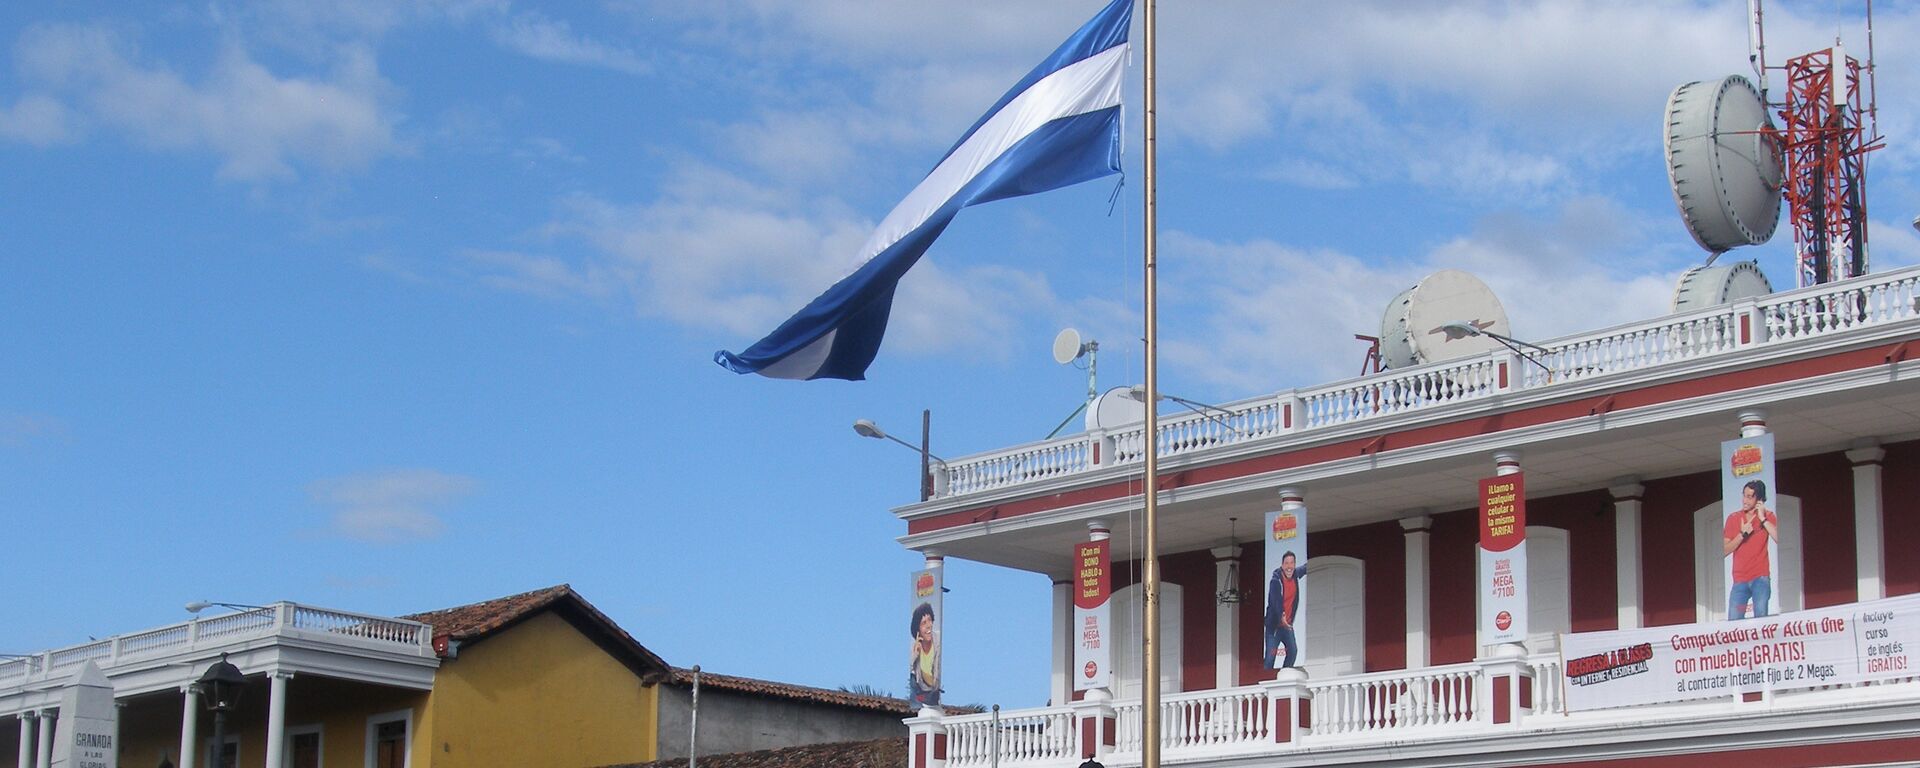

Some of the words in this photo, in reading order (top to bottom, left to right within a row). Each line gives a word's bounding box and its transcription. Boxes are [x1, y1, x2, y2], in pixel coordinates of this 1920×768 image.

[1510, 483, 1514, 491] a
[1487, 494, 1515, 505] cualquier
[1487, 505, 1509, 516] celular
[1487, 518, 1494, 527] la
[1494, 516, 1515, 526] misma
[1491, 525, 1514, 537] TARIFA!
[1093, 545, 1101, 555] mi
[1084, 557, 1099, 567] BONO
[1081, 567, 1098, 578] HABLO
[1098, 568, 1103, 576] a
[1083, 578, 1098, 587] todos
[1493, 575, 1514, 587] MEGA
[1497, 586, 1515, 598] 7100
[1863, 611, 1894, 624] Incluye
[1083, 630, 1100, 640] MEGA
[1671, 628, 1759, 652] Computadora
[1761, 623, 1778, 639] HP
[1784, 620, 1804, 637] All
[1806, 620, 1818, 635] in
[1821, 617, 1844, 633] One
[1865, 628, 1888, 640] curso
[1086, 640, 1100, 650] 7100
[1867, 644, 1877, 656] de
[1878, 641, 1903, 657] inglés
[1566, 654, 1610, 677] REGRESA
[1610, 651, 1618, 668] A
[1617, 643, 1653, 667] CLASES
[1675, 658, 1696, 674] con
[1700, 648, 1747, 671] mueble
[1748, 641, 1806, 671] ¡GRATIS!
[1867, 655, 1907, 673] ¡GRATIS!
[1580, 669, 1611, 686] INTERNET
[1611, 661, 1648, 680] RESIDENCIAL
[1677, 679, 1686, 692] al
[1688, 675, 1728, 691] contratar
[1729, 670, 1765, 687] Internet
[1767, 667, 1781, 685] Fijo
[1784, 666, 1795, 681] de
[1797, 664, 1804, 679] 2
[1806, 663, 1837, 681] Megas.
[76, 733, 112, 749] GRANADA
